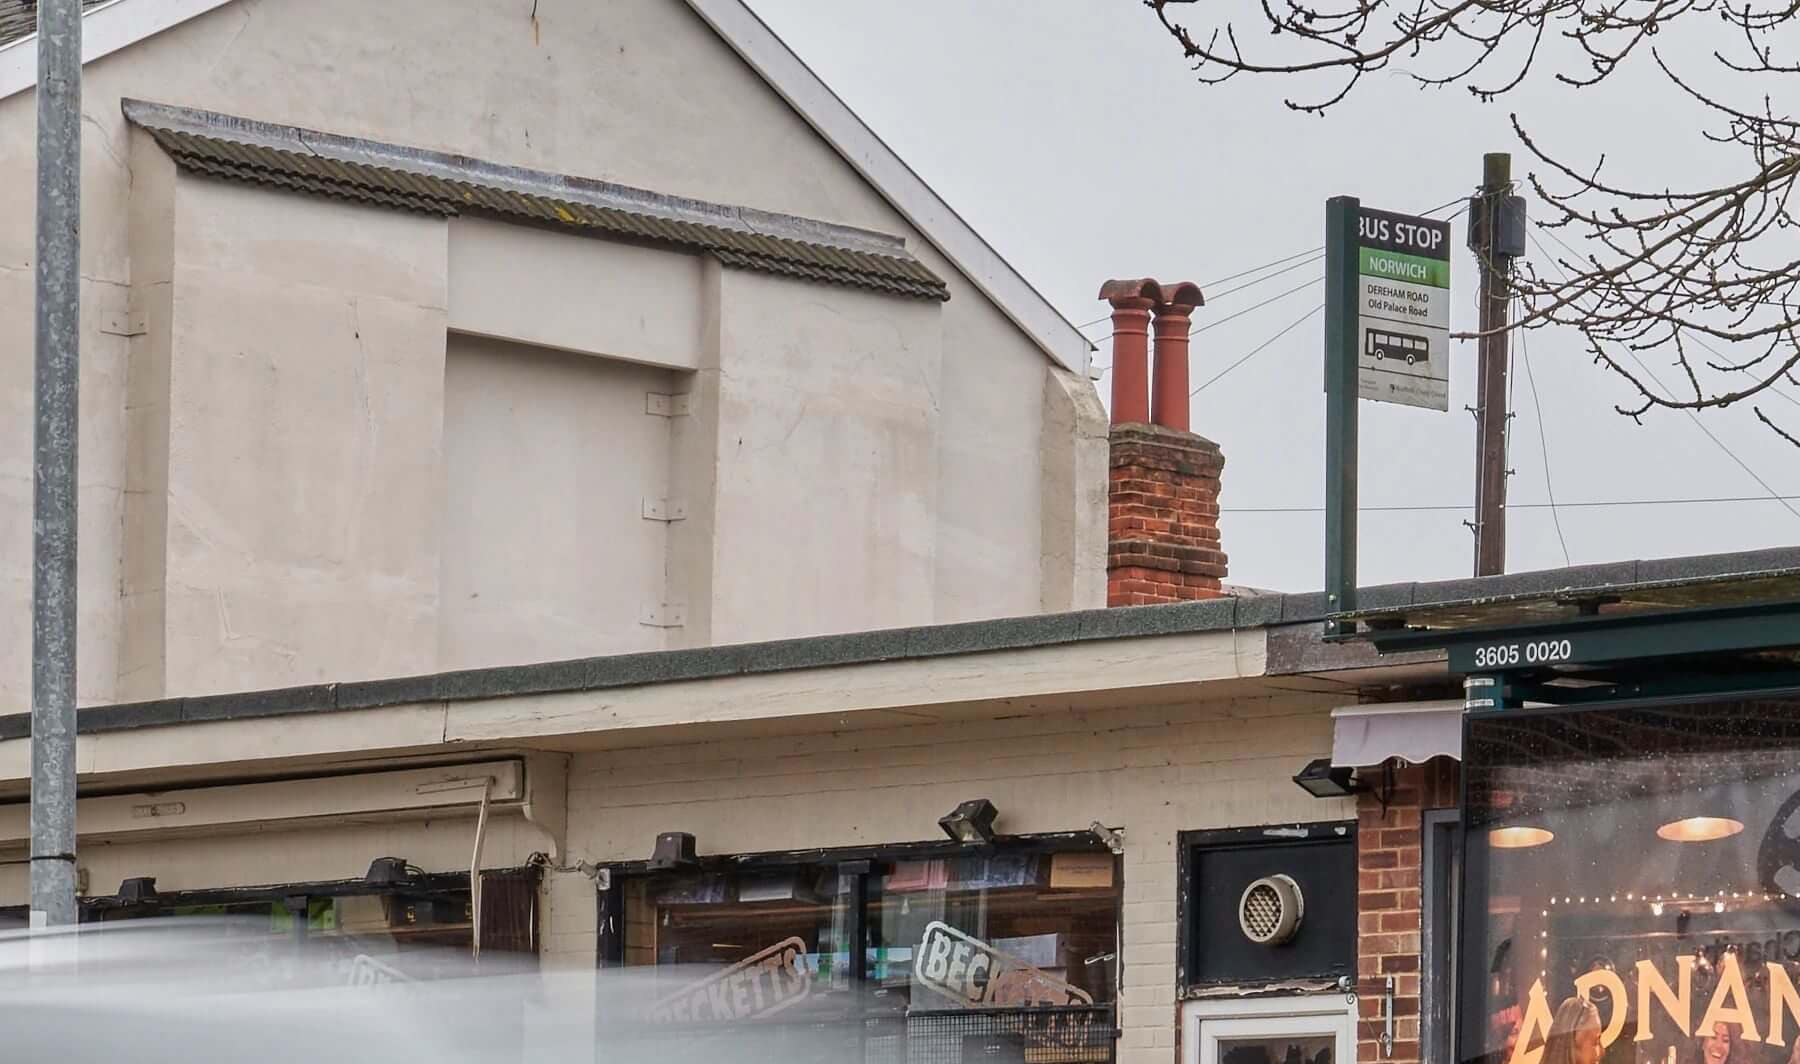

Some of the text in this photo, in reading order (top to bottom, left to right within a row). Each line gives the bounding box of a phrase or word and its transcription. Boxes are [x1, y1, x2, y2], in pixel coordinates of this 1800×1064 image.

[1395, 222, 1442, 250] STOP
[1369, 255, 1427, 280] NORWICH
[1367, 283, 1429, 304] DEREHAM ROAD
[1368, 300, 1428, 318] Old Palace Road
[1475, 639, 1571, 667] 3605 0020
